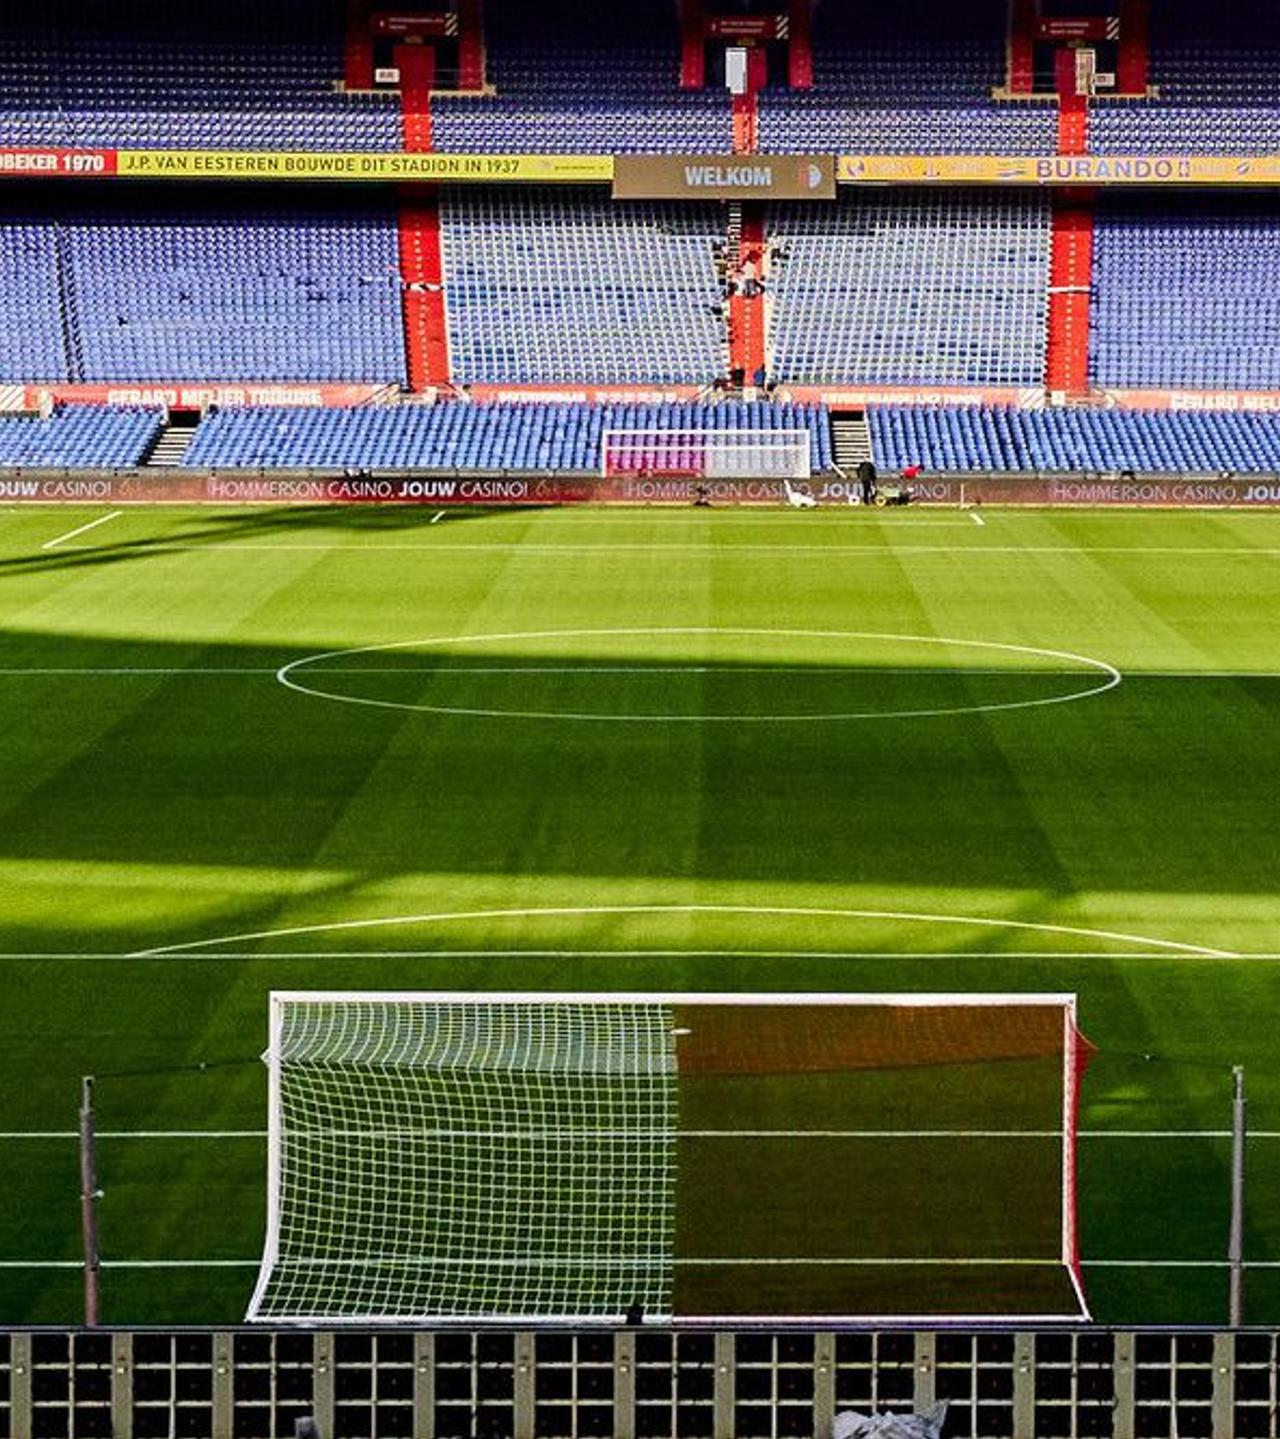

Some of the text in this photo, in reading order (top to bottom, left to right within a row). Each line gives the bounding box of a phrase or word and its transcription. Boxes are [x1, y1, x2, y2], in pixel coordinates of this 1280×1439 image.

[62, 155, 104, 171] 1970
[126, 157, 520, 173] J.P. VAN EESTEREN BOUWDE DIT STADION IN 1937
[1036, 160, 1173, 179] BURANDO
[685, 166, 773, 187] WELKOM
[42, 482, 112, 497] CASINO!
[208, 481, 528, 498] HOMMERSON CASINO, JOUW CASINO!
